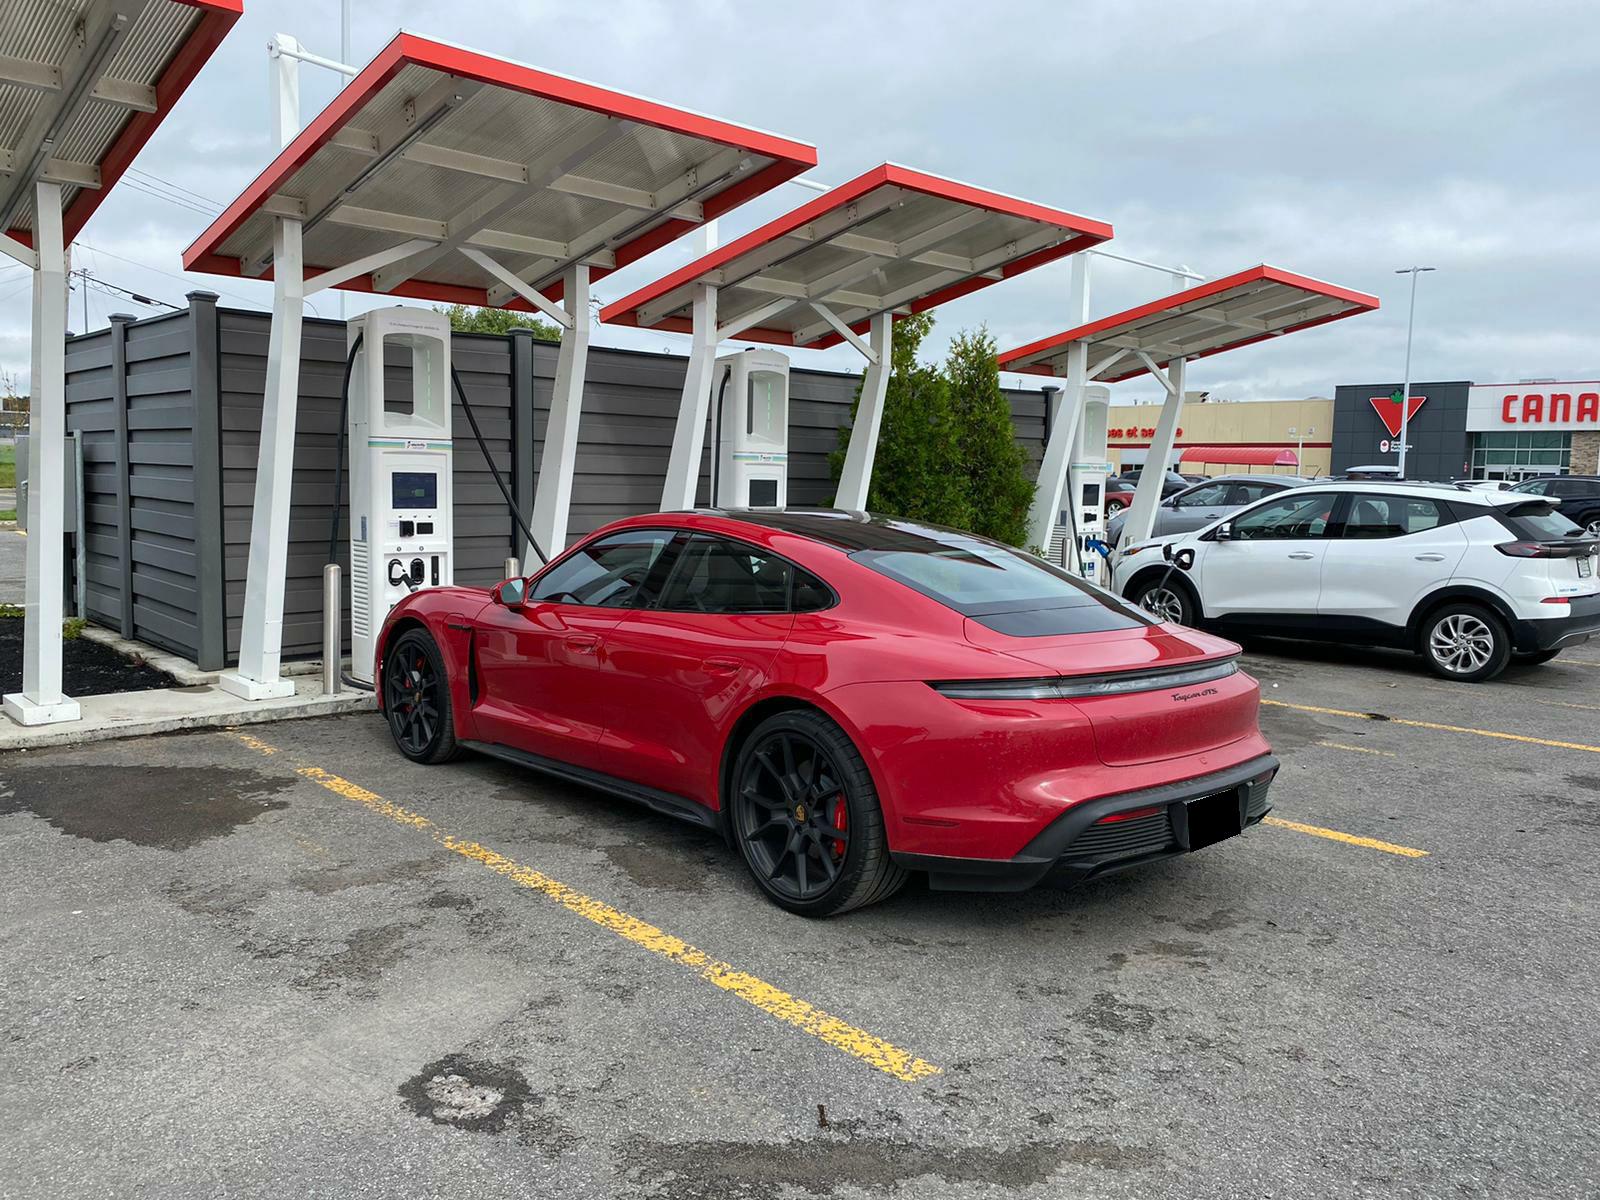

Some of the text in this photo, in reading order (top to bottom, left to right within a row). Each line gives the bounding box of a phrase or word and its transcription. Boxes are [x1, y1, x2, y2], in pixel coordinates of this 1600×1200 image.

[1502, 393, 1599, 423] CANA
[1126, 426, 1138, 438] et
[1171, 688, 1218, 702] Taycan GTS
